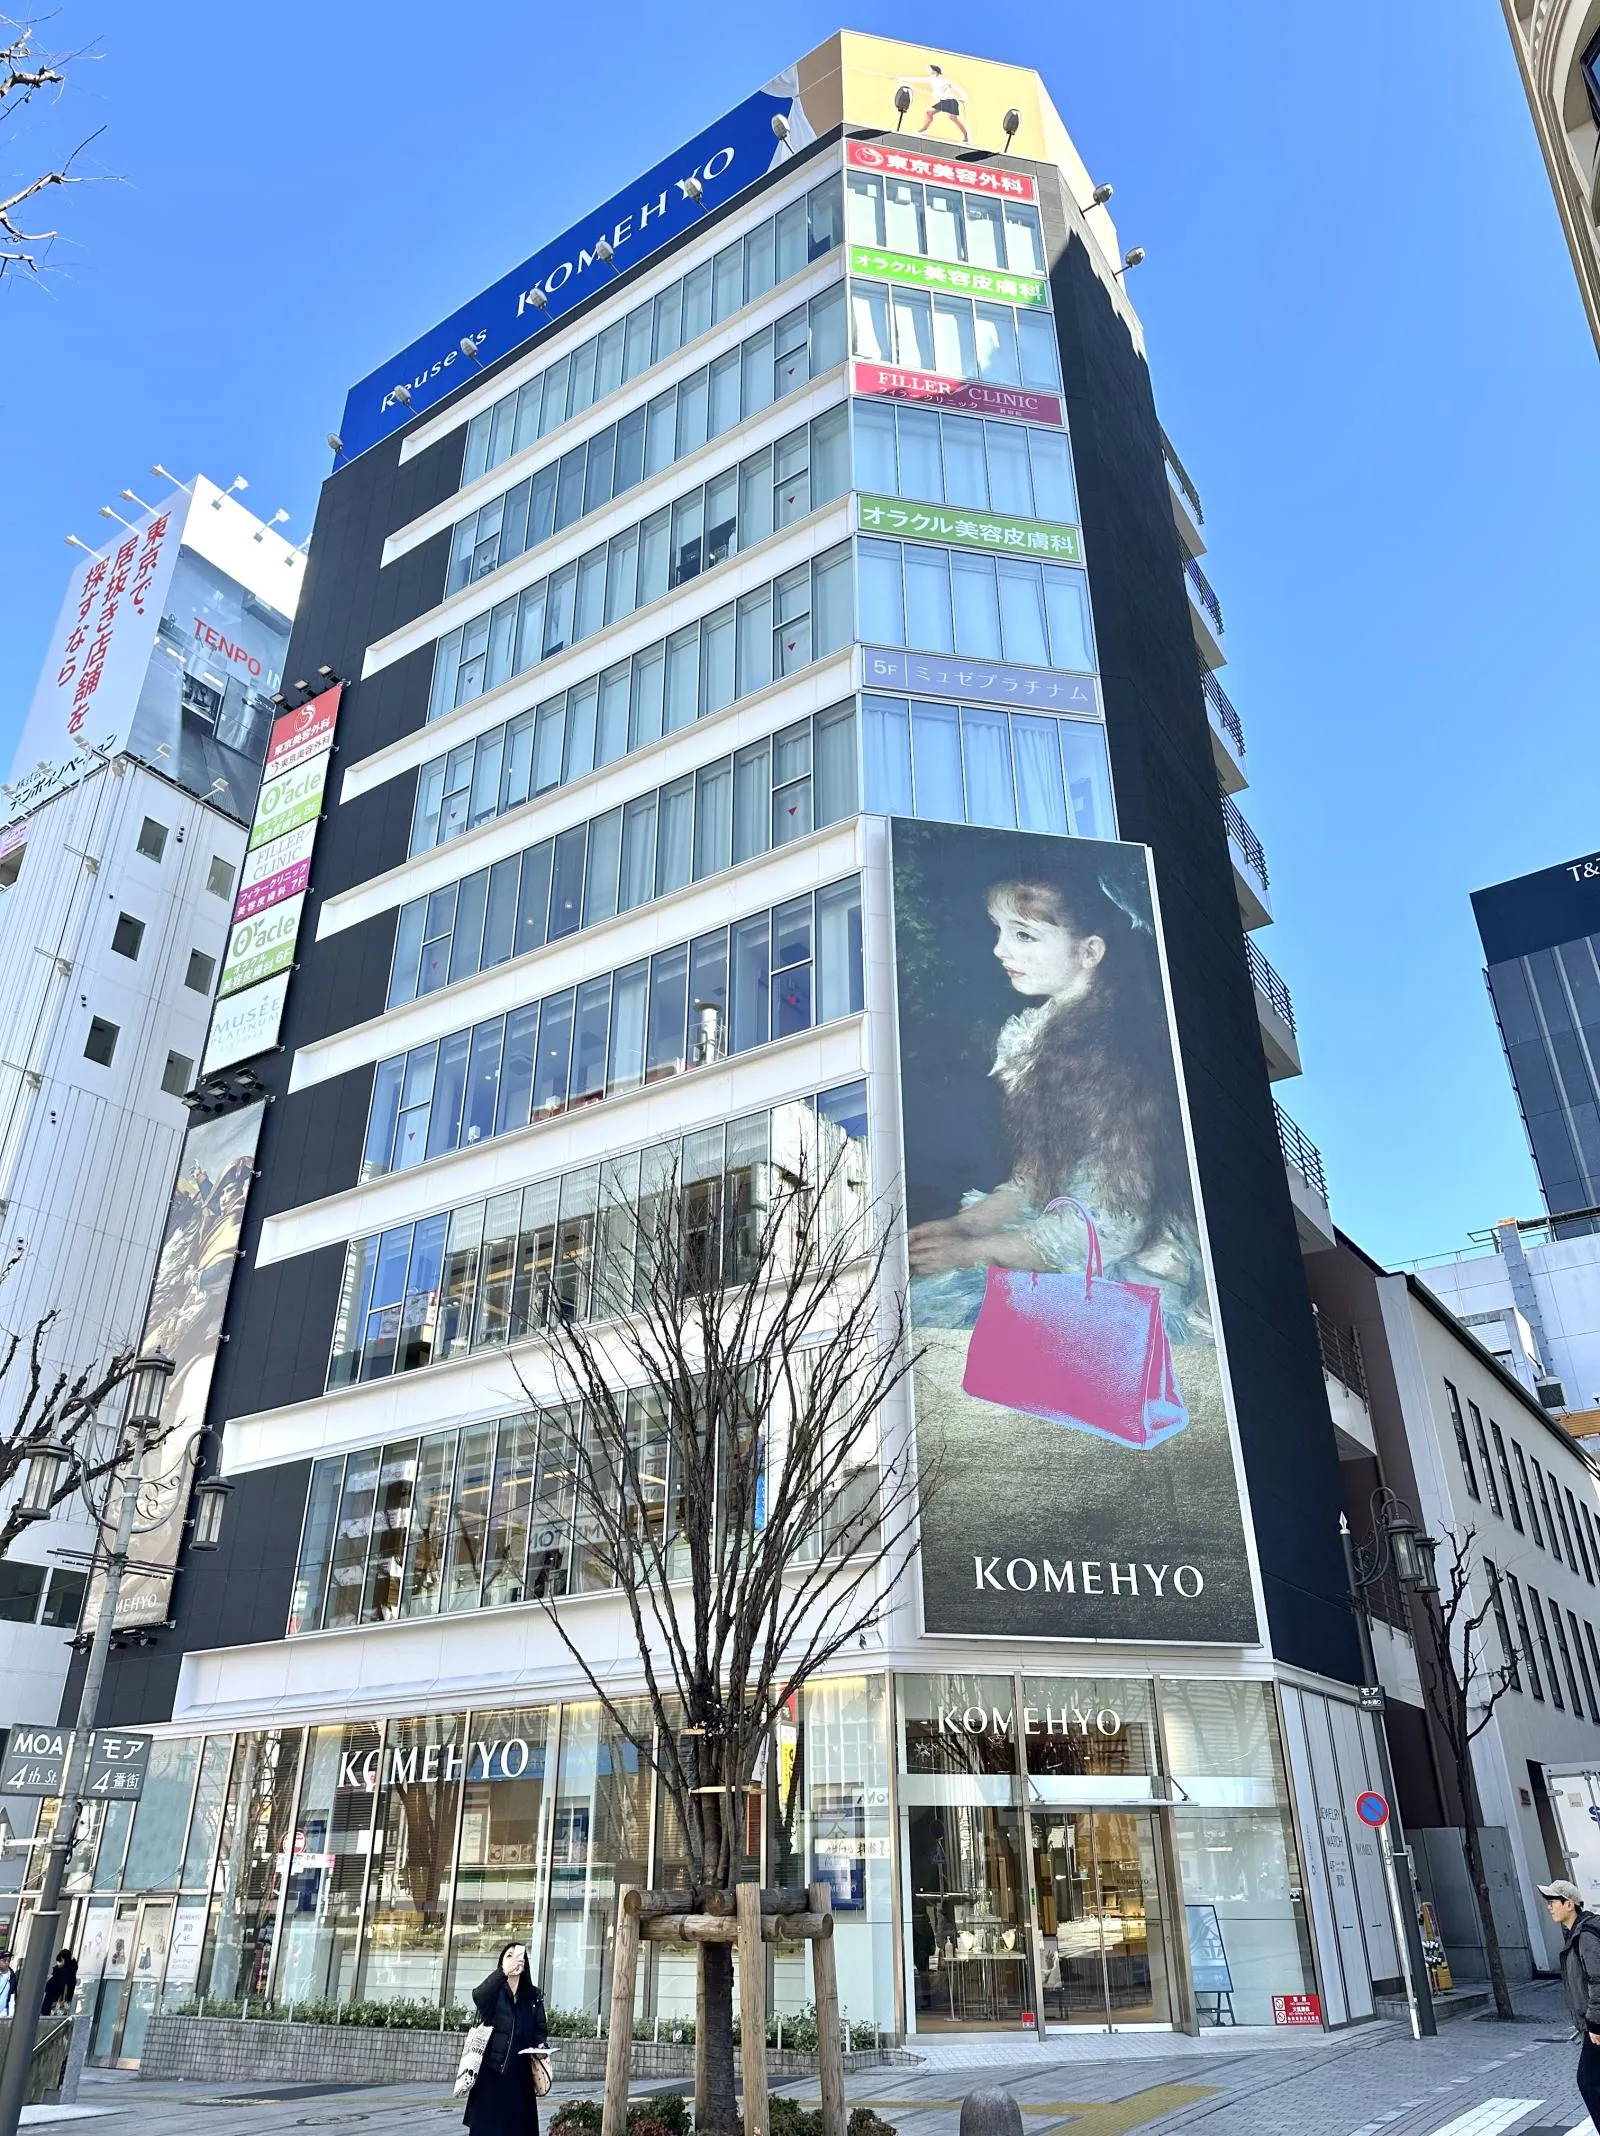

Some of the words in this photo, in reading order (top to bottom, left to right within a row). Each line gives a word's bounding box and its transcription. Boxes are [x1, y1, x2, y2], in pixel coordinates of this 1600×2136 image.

[886, 153, 1024, 195] 東京美容外科
[877, 371, 952, 395] FILLER
[968, 386, 1039, 410] CLINIC
[863, 506, 1074, 554] オラクル美容皮膚科
[57, 555, 110, 688] 探すなら
[67, 535, 139, 735] 居抜き店舗を
[192, 617, 262, 677] TENPO
[873, 660, 898, 676] 5F
[914, 665, 1089, 701] ミュゼプラチナム
[261, 773, 322, 816] Oracle
[253, 846, 302, 881] CLINIC
[256, 829, 304, 866] FILLER
[240, 862, 308, 904] フィラークリニック
[291, 875, 306, 891] 7F
[232, 914, 296, 958] Oracle
[275, 948, 294, 965] 6F
[973, 1555, 1205, 1599] KOMEHYO
[1360, 1687, 1379, 1696] モア
[938, 1705, 1121, 1737] KOMEHYO
[13, 1732, 63, 1756] MOA
[102, 1738, 145, 1760] モア
[7, 1763, 40, 1789] 4th
[91, 1768, 140, 1793] 4番街
